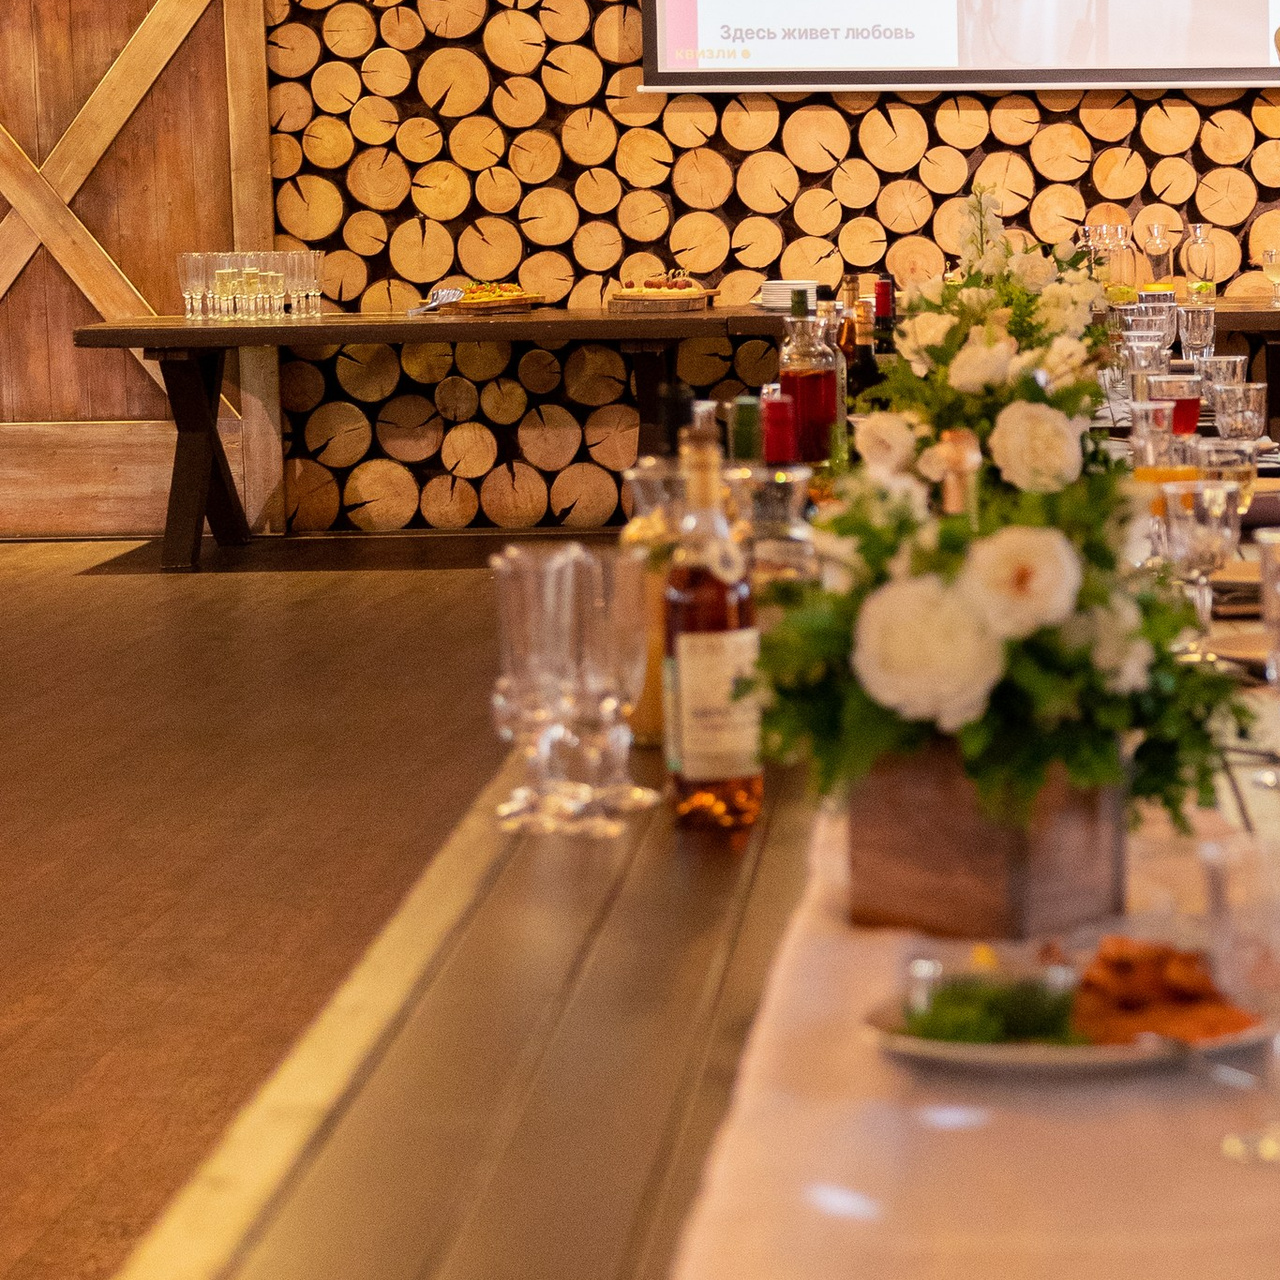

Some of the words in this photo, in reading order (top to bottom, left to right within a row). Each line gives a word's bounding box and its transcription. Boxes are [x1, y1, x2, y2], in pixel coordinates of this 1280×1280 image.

[720, 24, 777, 42] Здесь
[781, 26, 840, 40] живет
[845, 24, 915, 40] любовь
[675, 48, 737, 59] квизли
